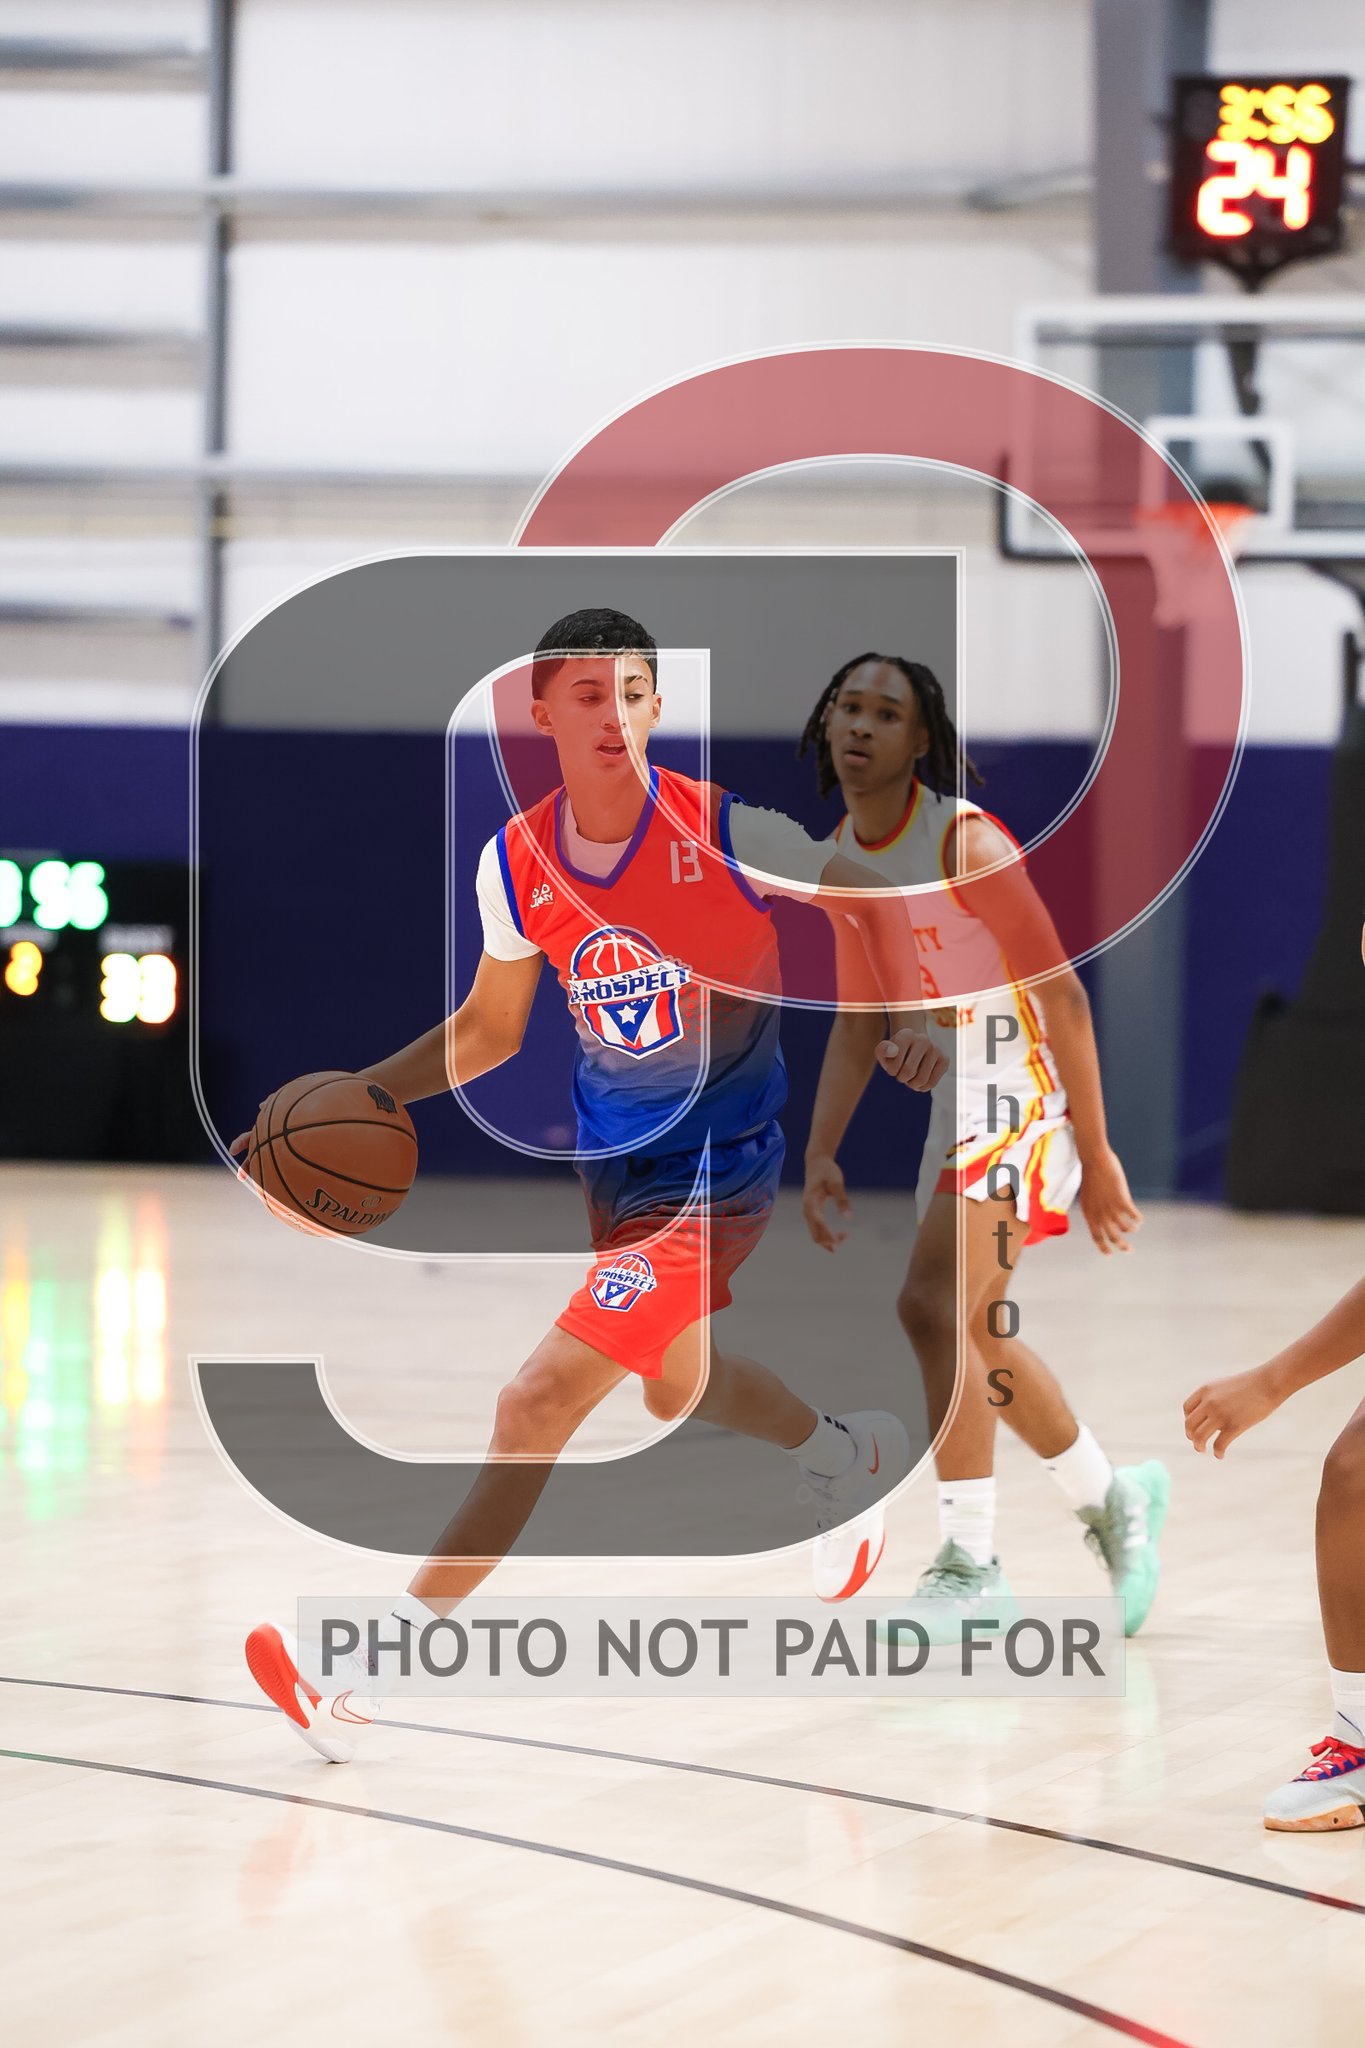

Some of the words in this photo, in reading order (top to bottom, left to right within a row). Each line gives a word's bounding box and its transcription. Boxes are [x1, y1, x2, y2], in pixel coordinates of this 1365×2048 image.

[1197, 139, 1312, 236] 24
[670, 840, 704, 884] 13
[305, 1188, 398, 1226] SPALDIN
